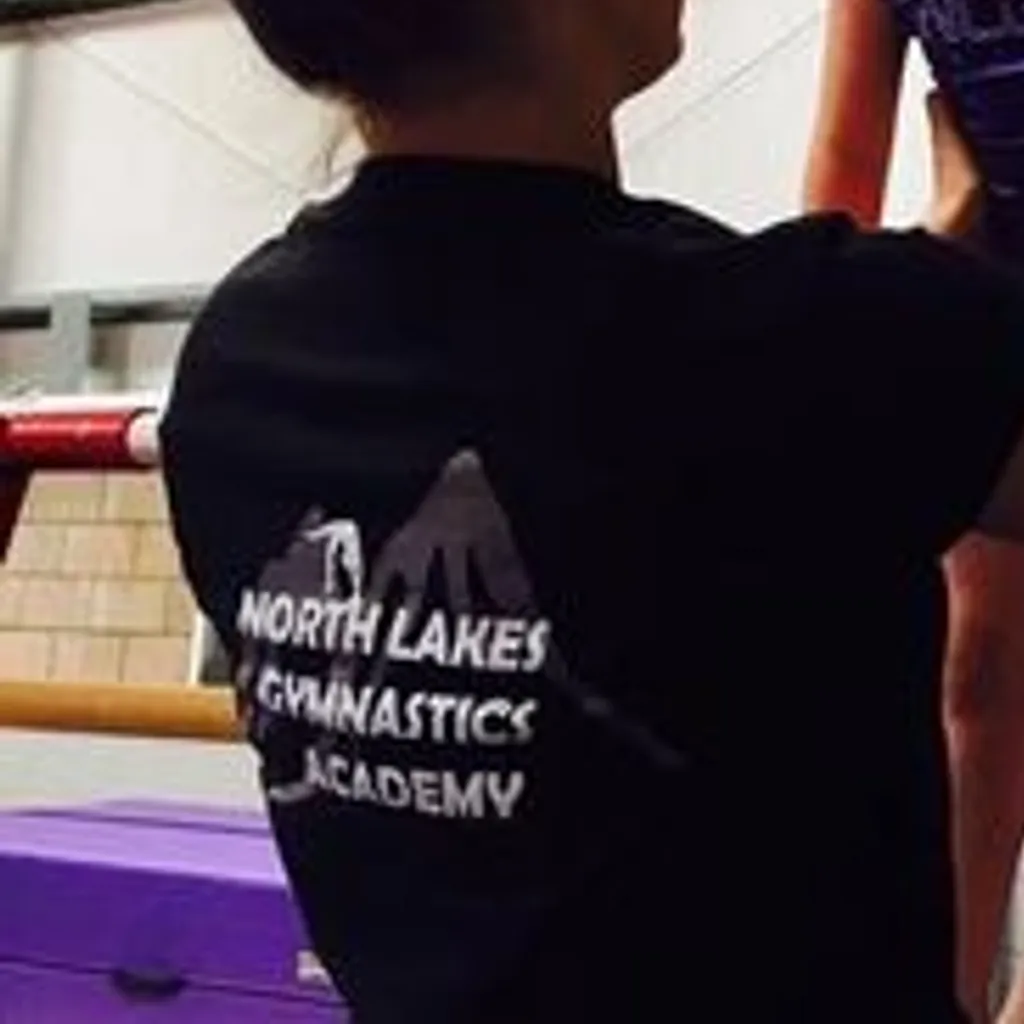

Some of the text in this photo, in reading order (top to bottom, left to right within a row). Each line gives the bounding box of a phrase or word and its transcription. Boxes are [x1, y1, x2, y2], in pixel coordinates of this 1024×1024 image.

[237, 589, 551, 672] NORTH LAKES
[257, 668, 539, 743] GYMNASTICS
[304, 748, 525, 818] ACADEMY
